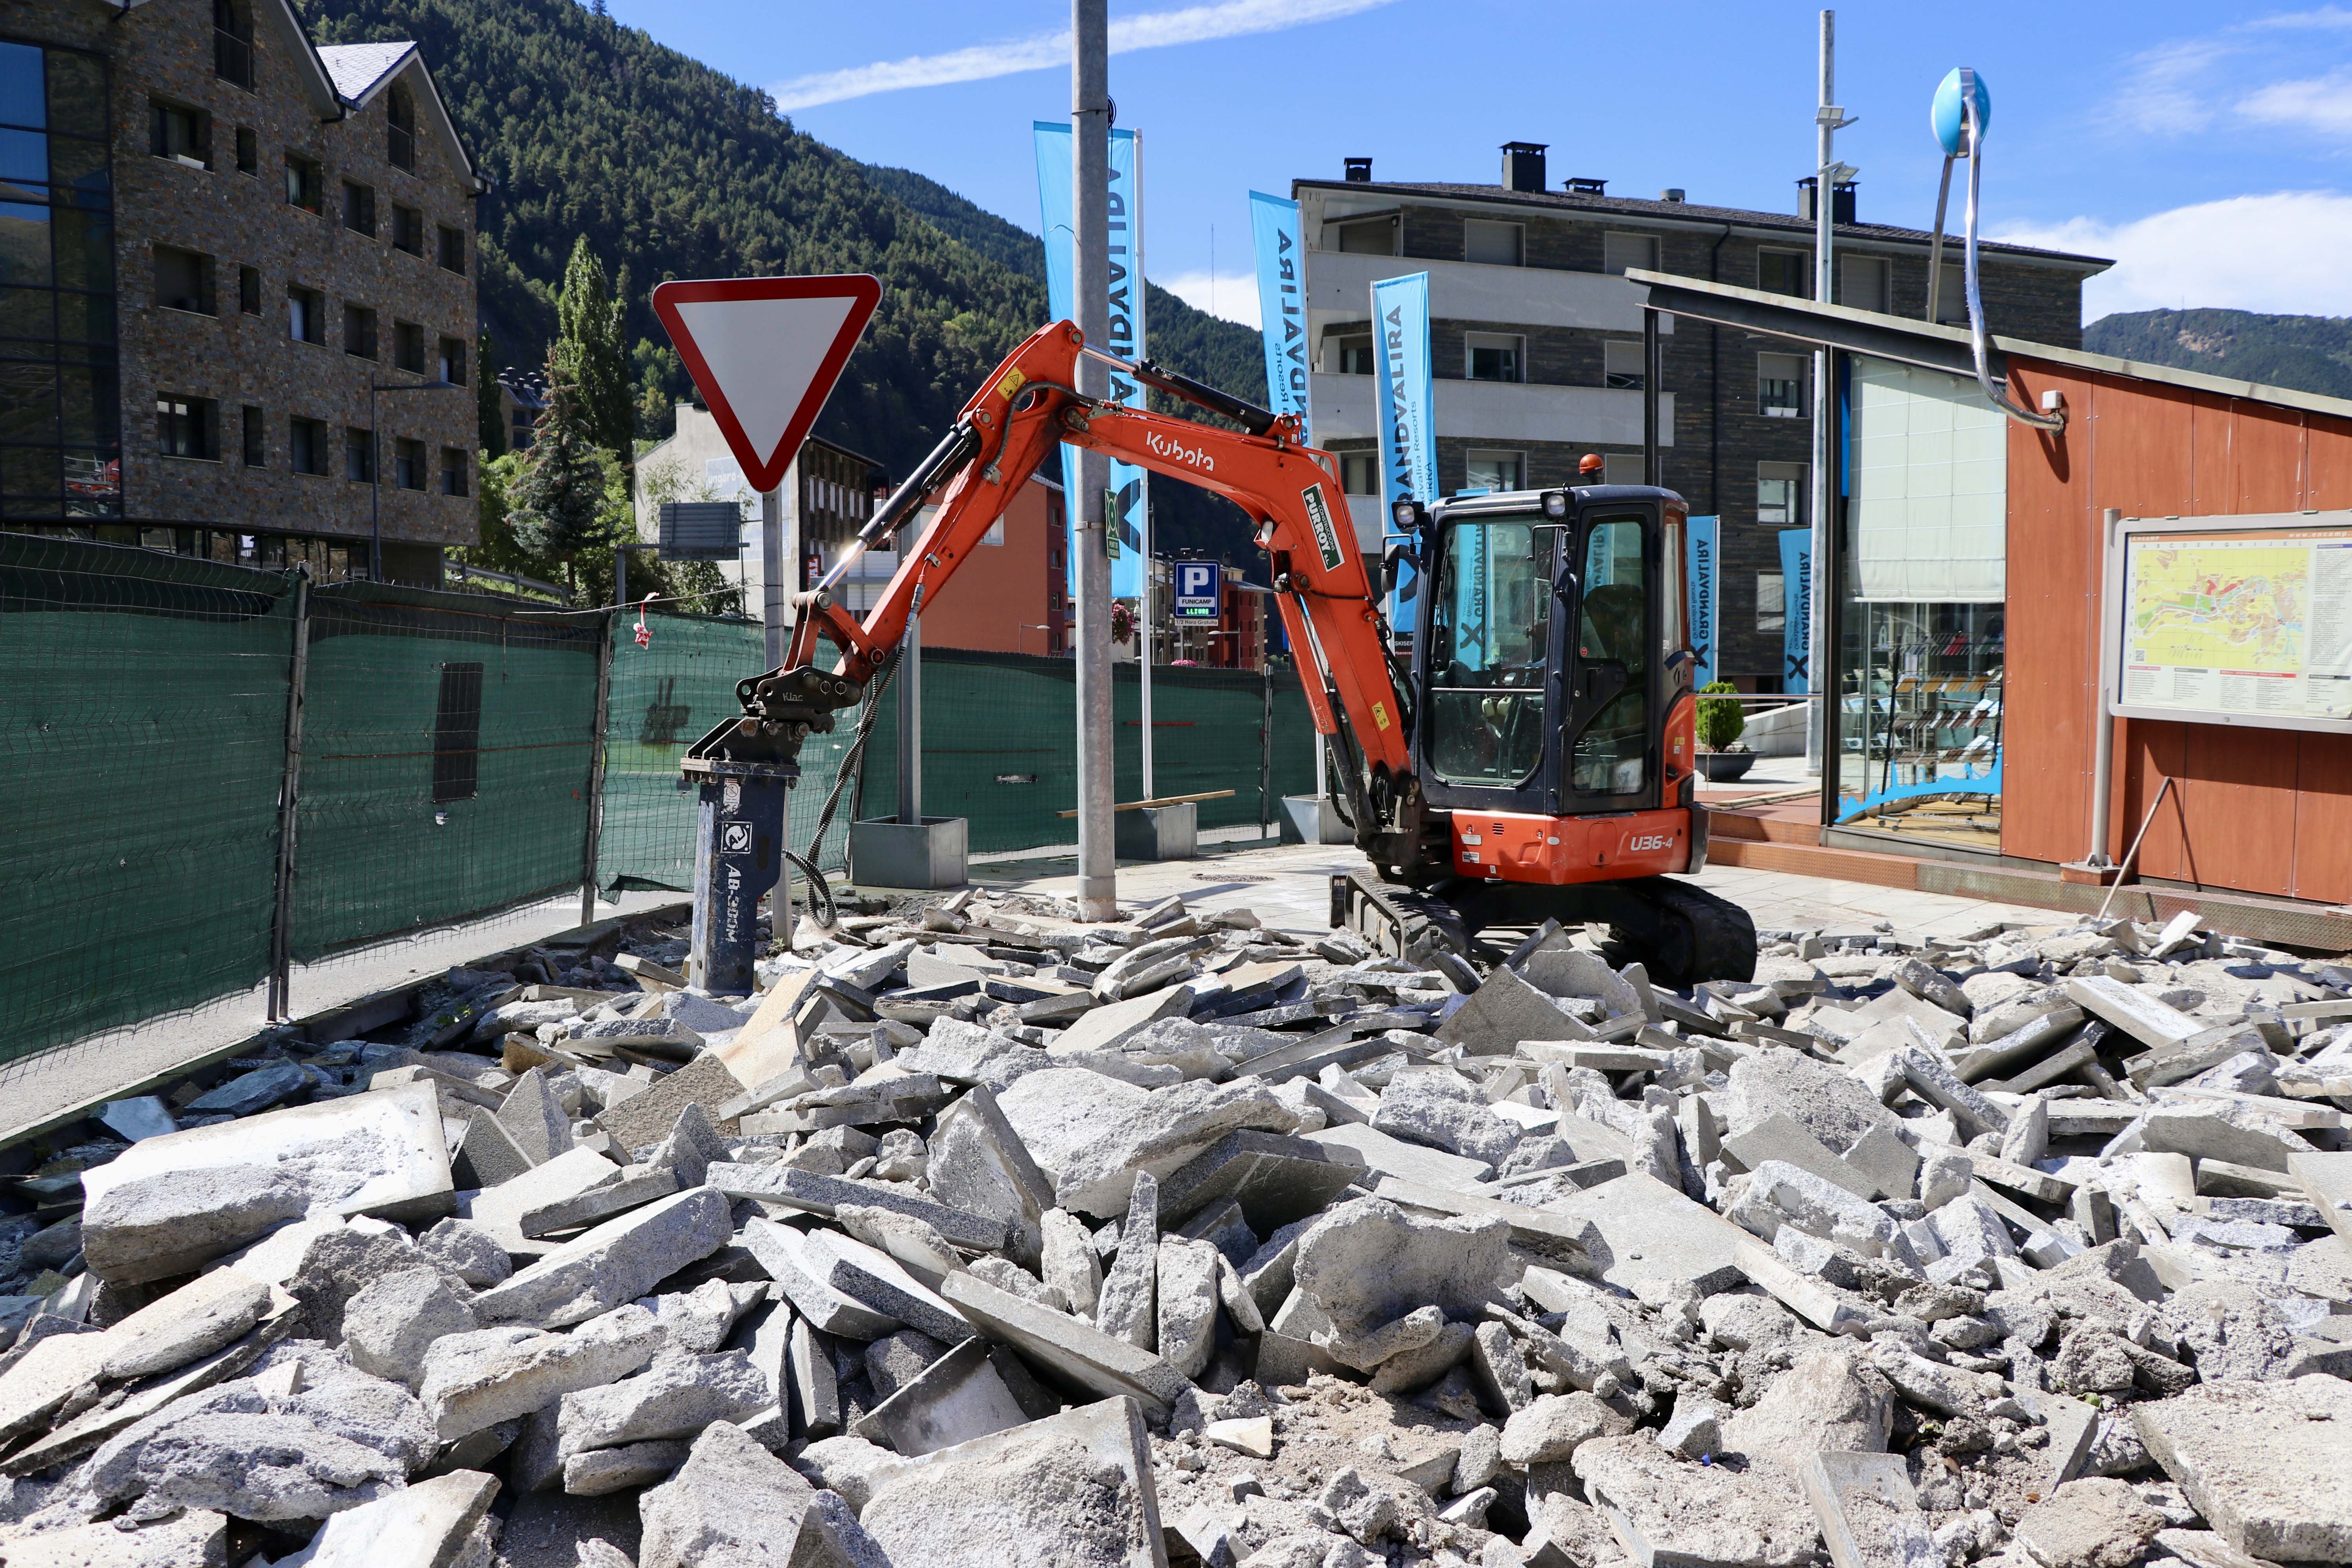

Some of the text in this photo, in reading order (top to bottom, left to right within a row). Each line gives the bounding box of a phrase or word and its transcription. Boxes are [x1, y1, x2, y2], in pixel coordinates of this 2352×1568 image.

[1411, 401, 1420, 451] Resorts
[1146, 431, 1214, 471] Kubota
[1305, 492, 1331, 551] PURROY
[1318, 505, 1336, 552] CONSTRUCCIONS
[1185, 567, 1209, 595] P
[782, 692, 803, 701] Klac
[1630, 835, 1673, 851] U36-4
